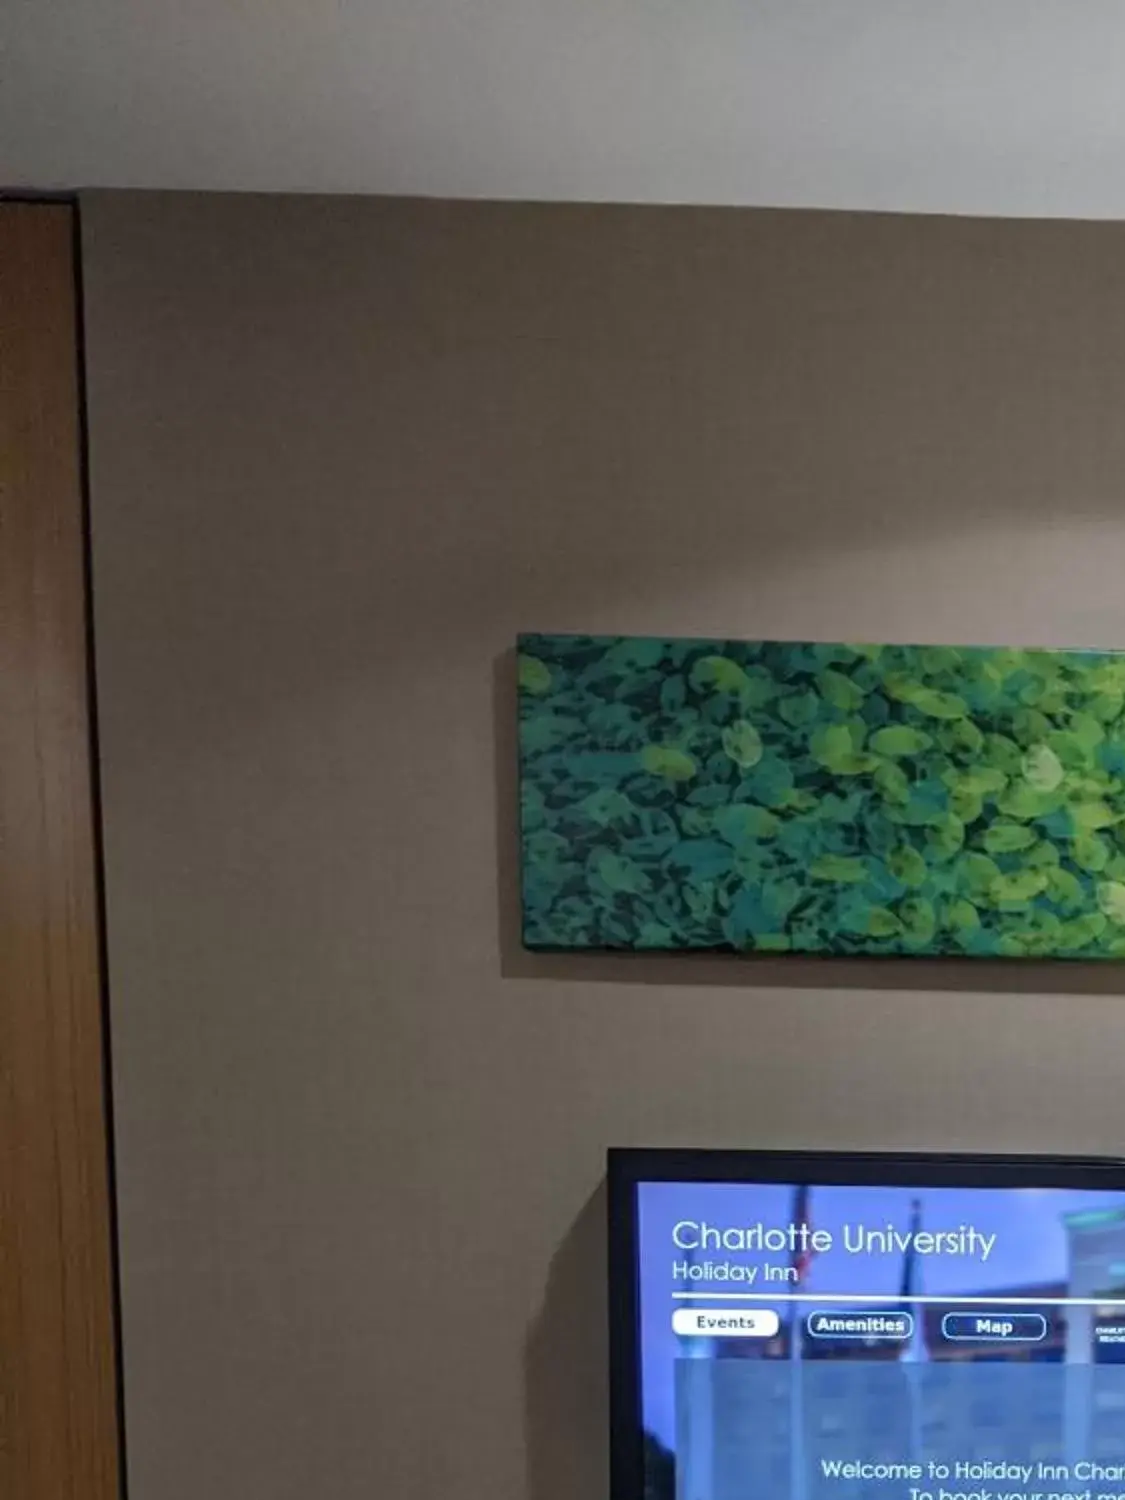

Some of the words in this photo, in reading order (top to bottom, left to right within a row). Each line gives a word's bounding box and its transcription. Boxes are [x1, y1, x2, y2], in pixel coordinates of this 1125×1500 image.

[672, 1221, 833, 1253] Charlotte
[843, 1223, 997, 1261] University
[672, 1260, 757, 1284] Holiday
[763, 1262, 799, 1282] Inn
[696, 1315, 756, 1329] Events
[816, 1316, 905, 1333] Amenities
[975, 1318, 1014, 1336] Map
[821, 1460, 922, 1480] Welcome
[928, 1462, 950, 1480] to
[954, 1461, 1033, 1484] Holiday
[1038, 1462, 1070, 1481] Inn
